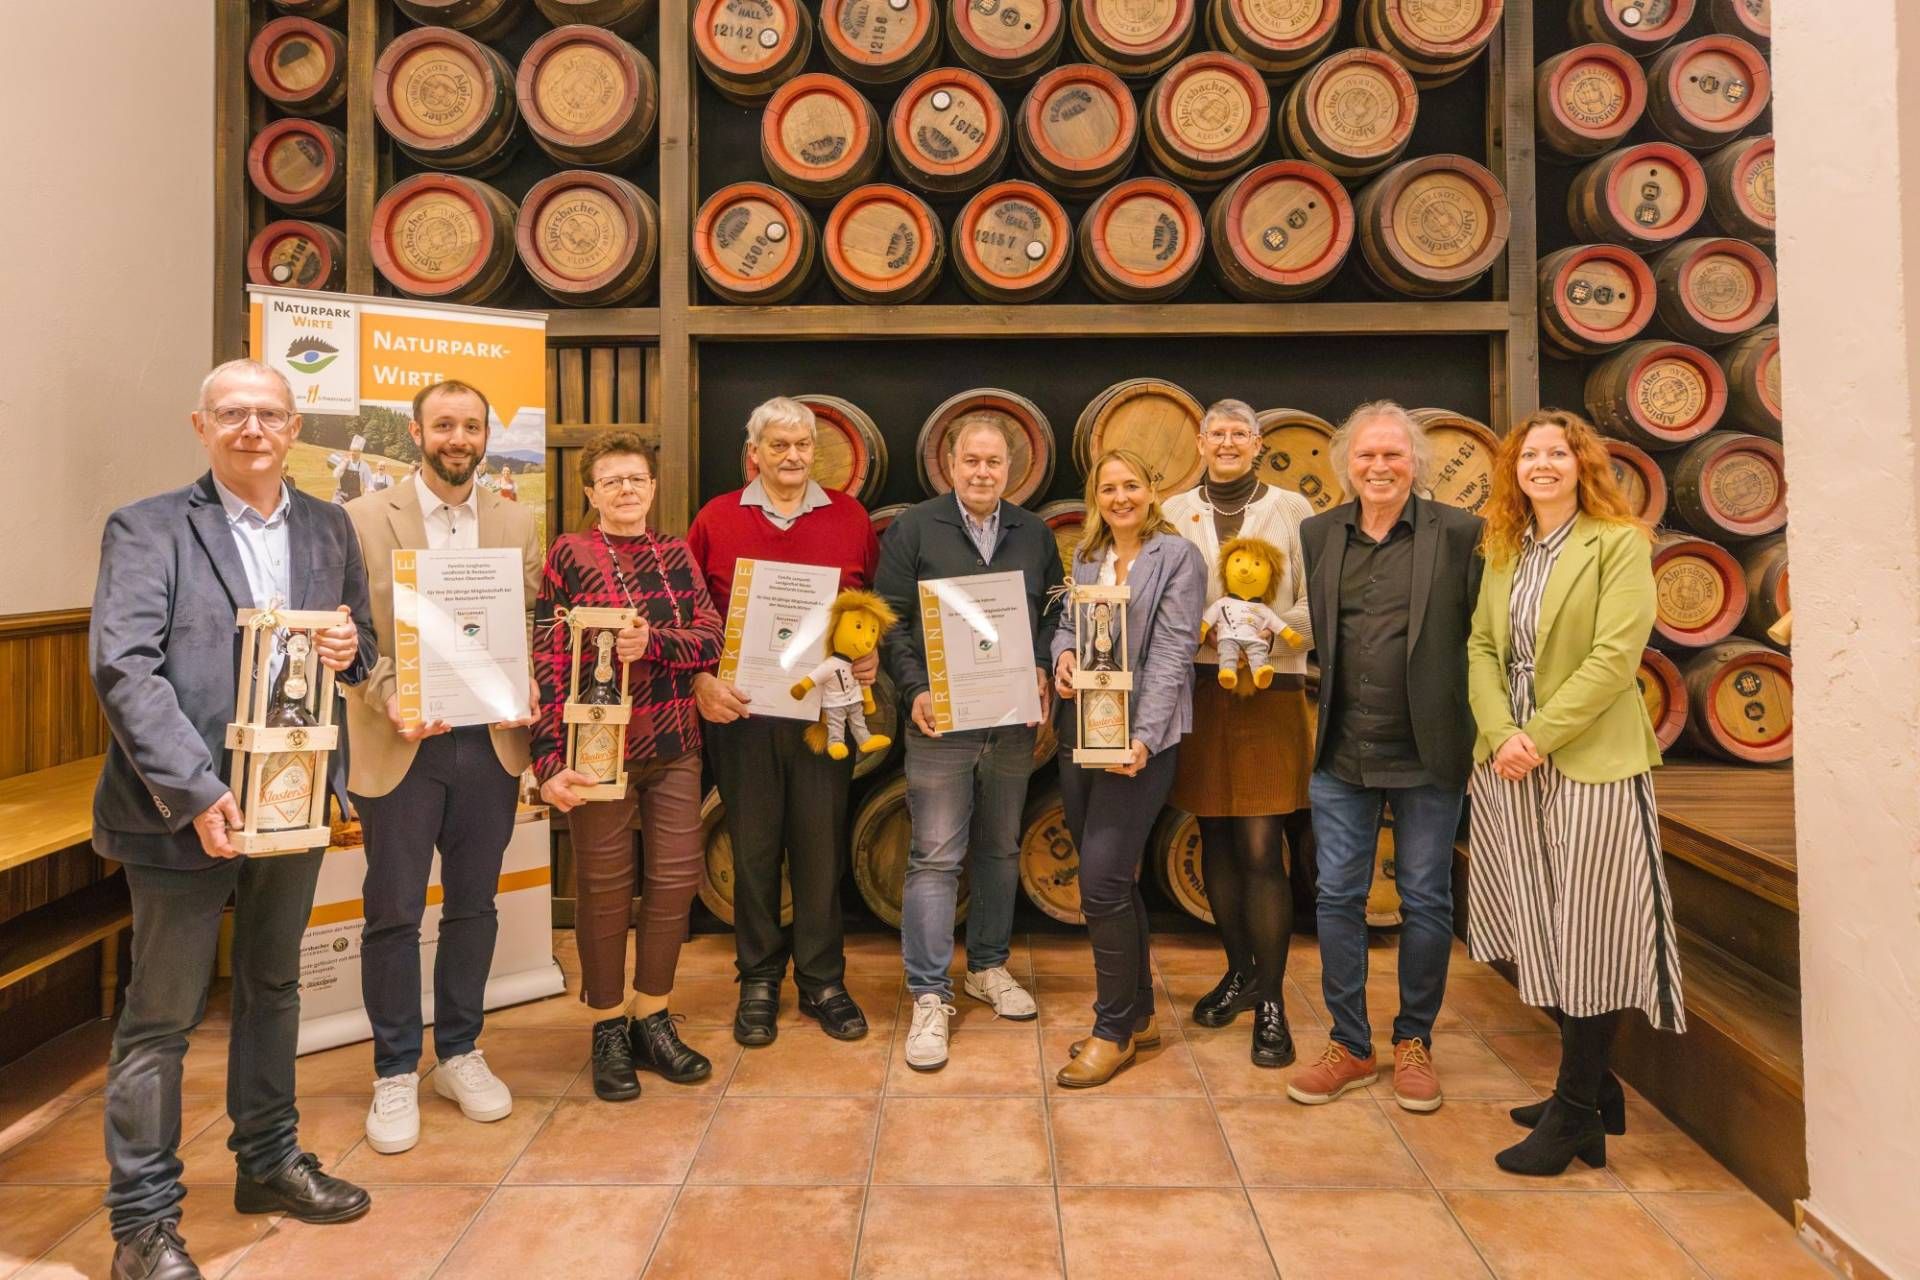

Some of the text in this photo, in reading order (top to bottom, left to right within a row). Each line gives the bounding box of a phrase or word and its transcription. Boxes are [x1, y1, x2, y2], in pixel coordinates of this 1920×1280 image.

[714, 23, 753, 39] 12142
[1179, 80, 1231, 128] Alpirsbacher
[1325, 90, 1377, 138] Alpirsbacher
[405, 209, 442, 271] Alpirsbacher
[548, 202, 600, 252] Alpirsbacher
[1416, 209, 1475, 252] Alpirsbacher
[273, 301, 350, 318] NATURPARK
[292, 315, 334, 329] WIRTE
[373, 330, 511, 359] NATURPARK-
[1640, 369, 1675, 424] Alpirsbacher
[1439, 440, 1475, 481] 13451
[1456, 482, 1478, 503] HALL
[1663, 564, 1713, 599] Alpirsbacher
